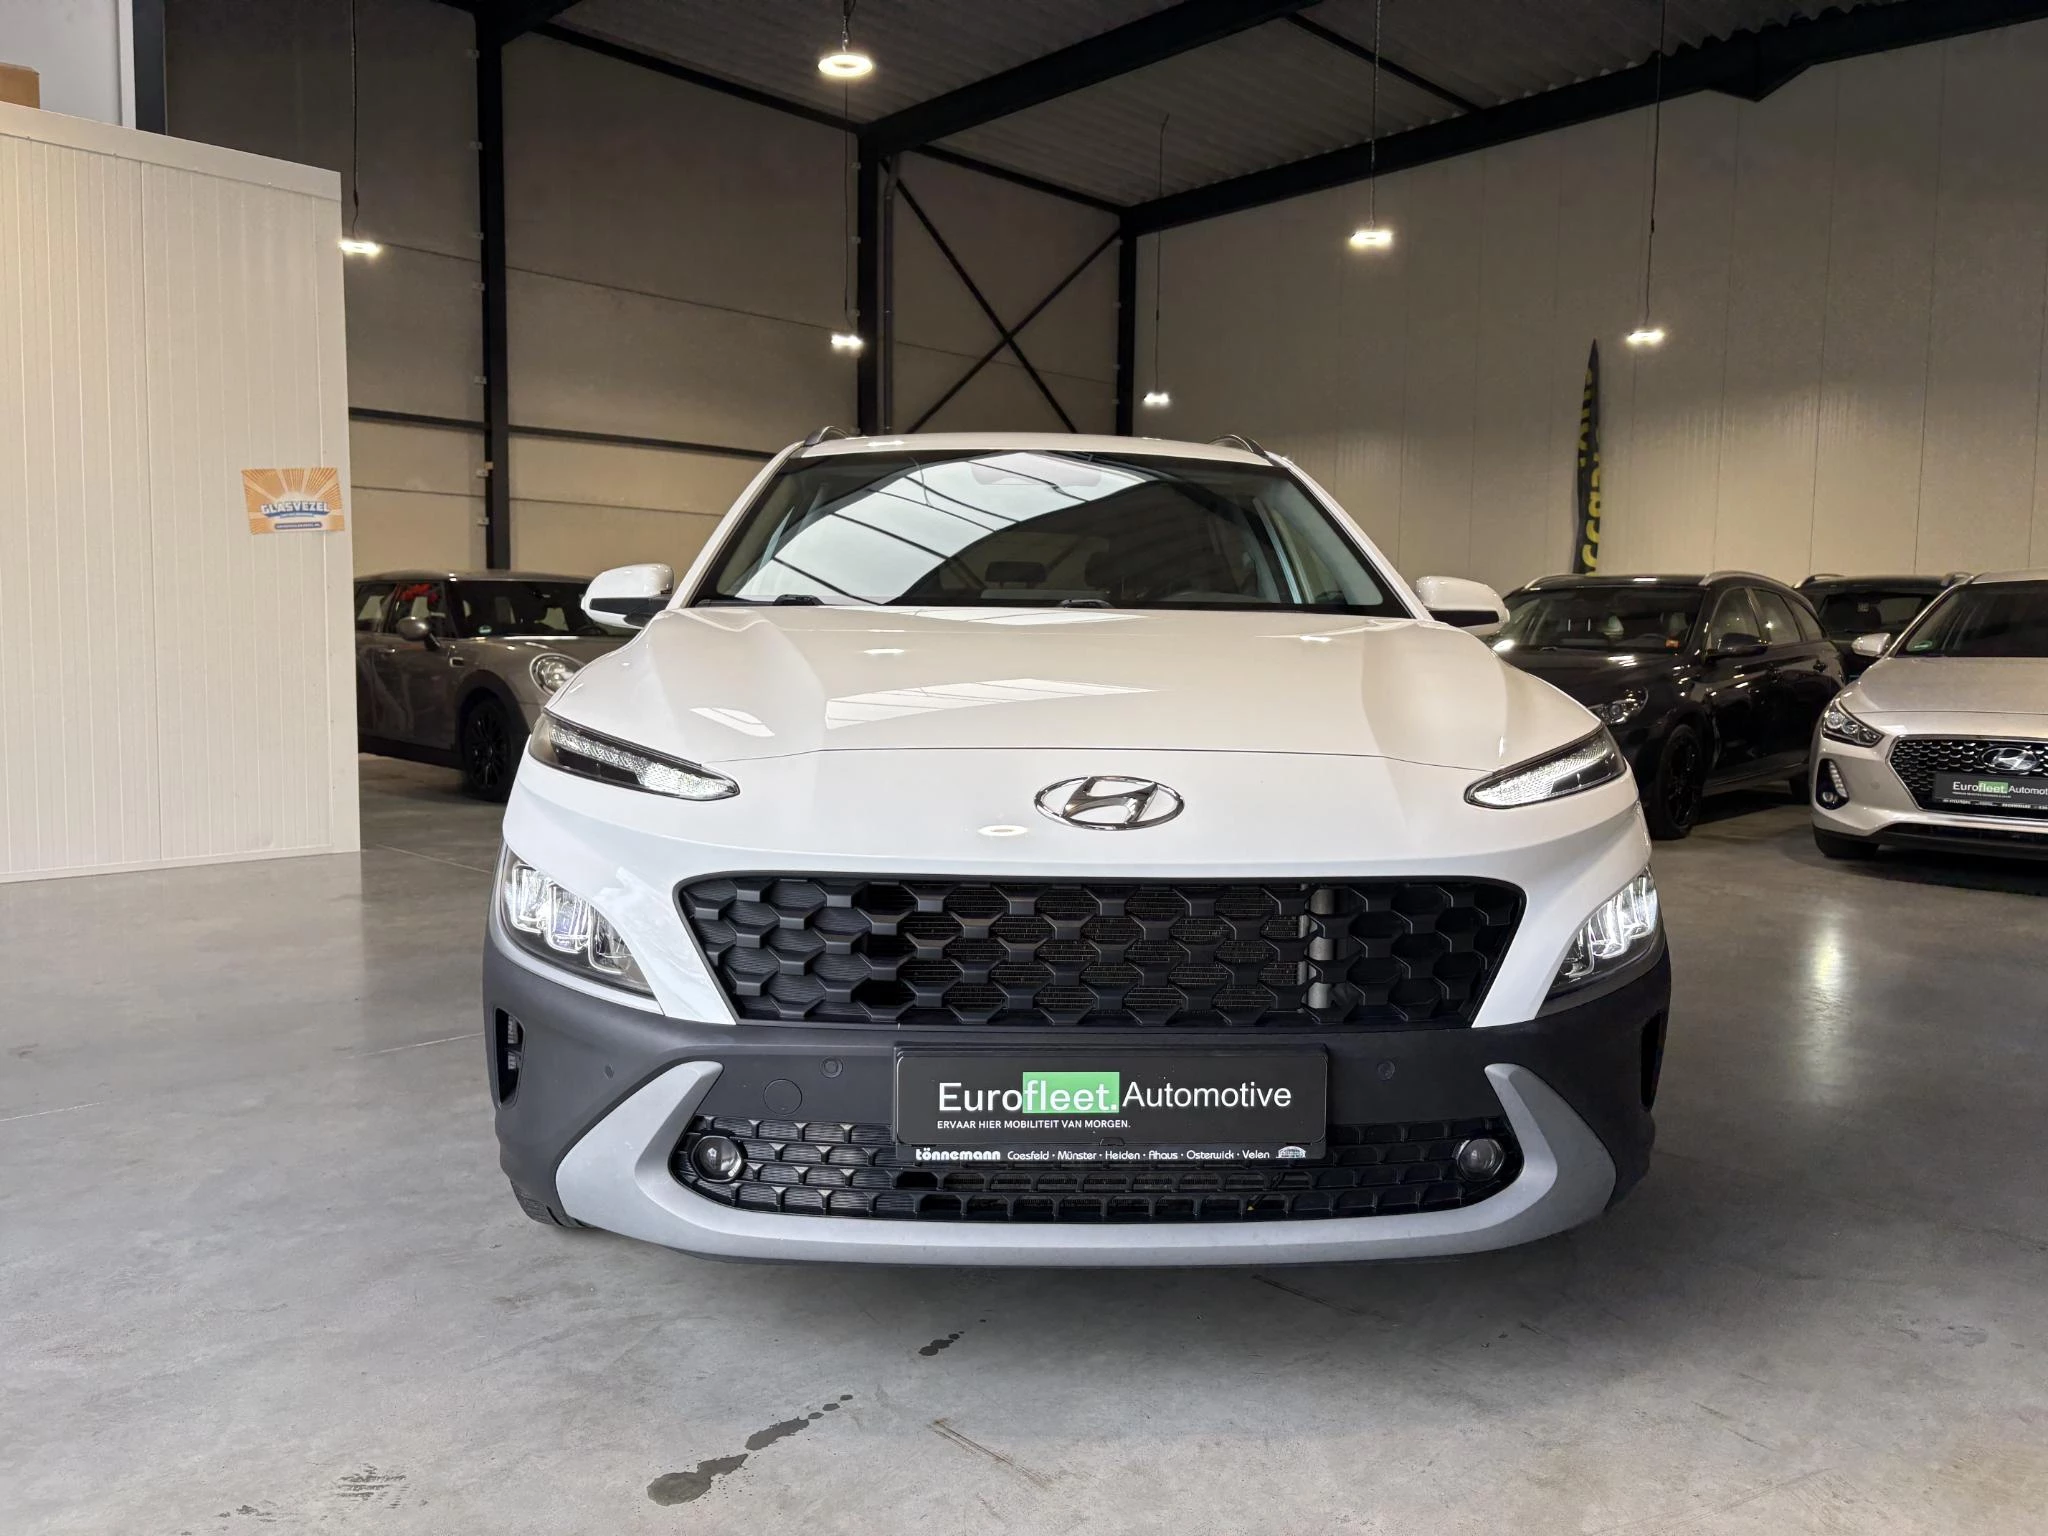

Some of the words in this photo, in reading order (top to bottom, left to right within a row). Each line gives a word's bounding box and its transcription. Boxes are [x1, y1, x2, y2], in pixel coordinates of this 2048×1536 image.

[260, 501, 330, 513] GLASVEZEL
[1122, 1081, 1292, 1107] Automotive
[937, 1120, 977, 1129] ERVAAR
[979, 1120, 1002, 1129] HIER
[1004, 1119, 1060, 1129] MOBILITEIT
[1061, 1119, 1083, 1128] VAN
[1085, 1119, 1132, 1128] MORGEN.
[915, 1147, 1001, 1160] tönnemann
[1007, 1150, 1050, 1161] Coesfeld
[1057, 1149, 1097, 1161] Münster
[1105, 1150, 1140, 1160] Heiden
[1148, 1149, 1179, 1160] Ahaus
[1186, 1150, 1235, 1160] Osterwick
[1242, 1149, 1270, 1160] Velen
